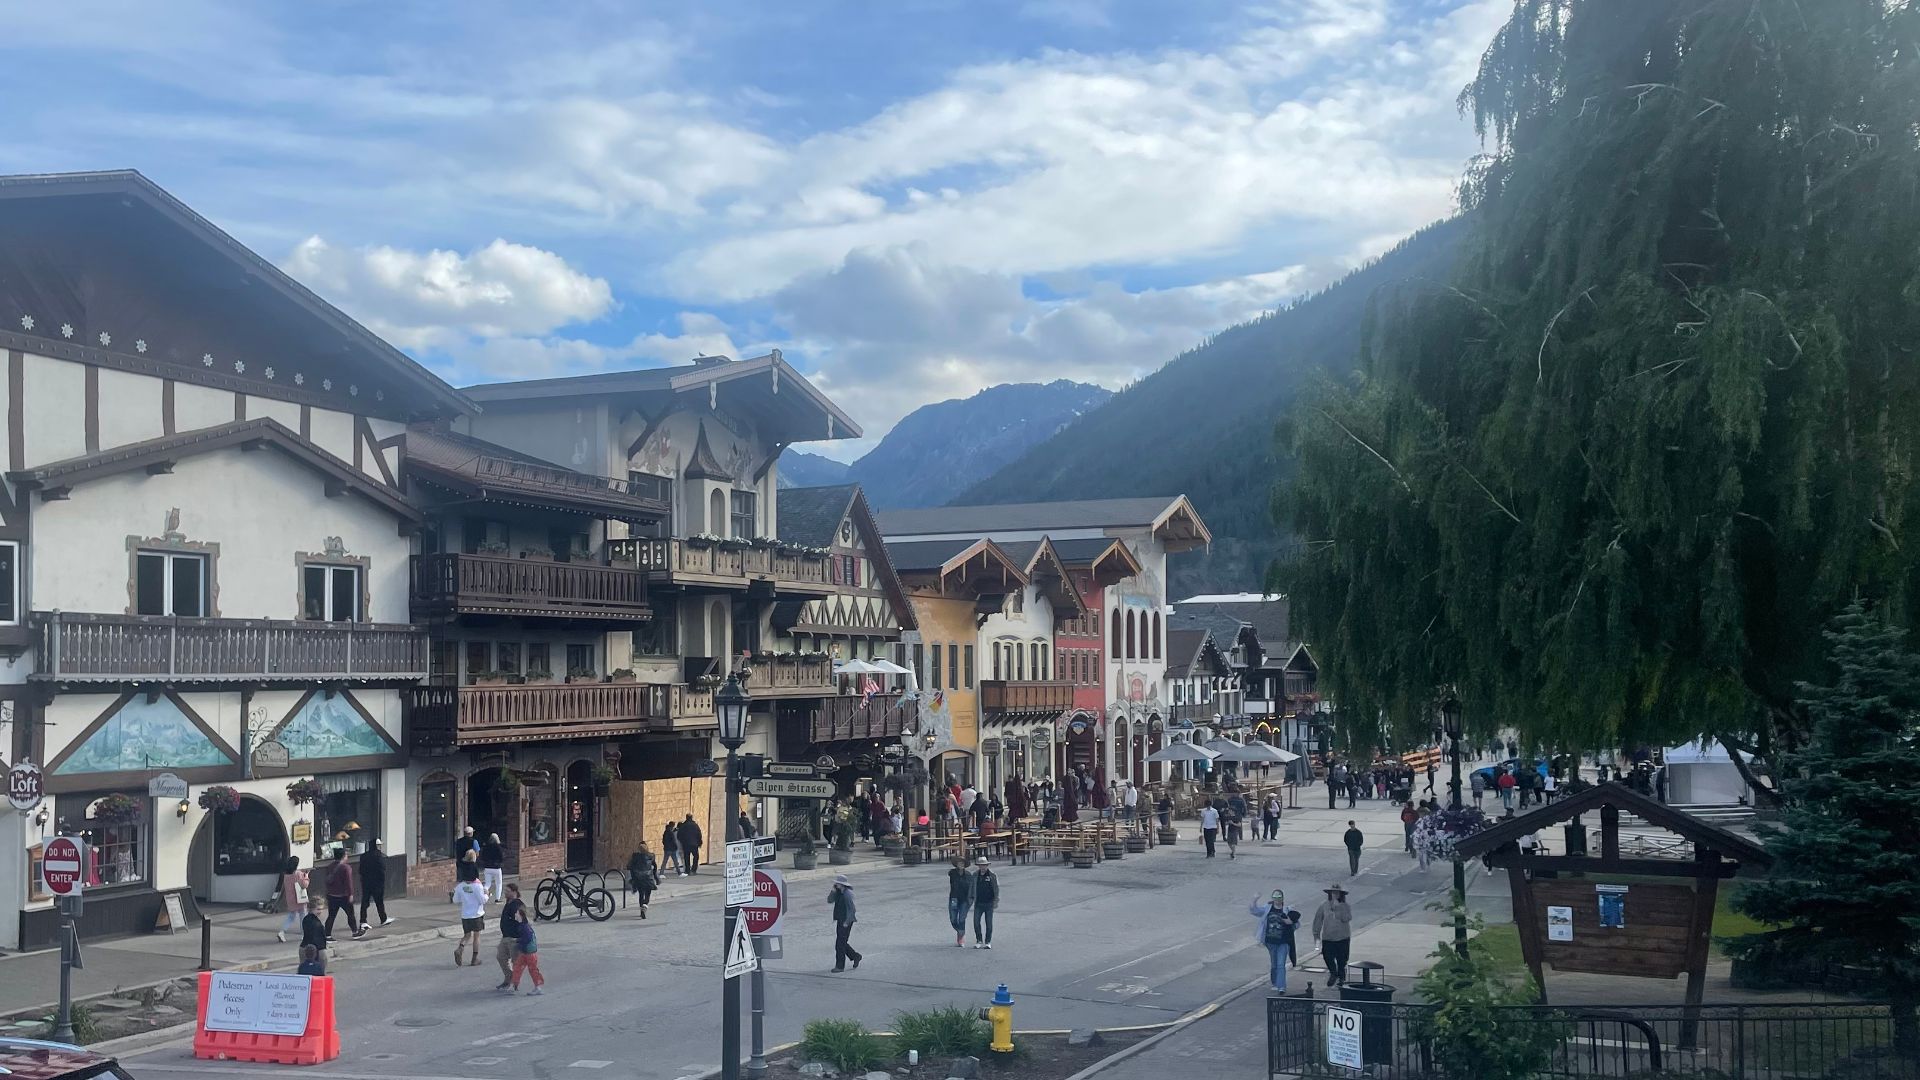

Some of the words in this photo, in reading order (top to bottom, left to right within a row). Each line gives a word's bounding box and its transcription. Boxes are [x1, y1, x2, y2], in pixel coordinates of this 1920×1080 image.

[10, 776, 38, 792] Loft
[757, 781, 784, 793] Alpen
[787, 782, 827, 794] Strasse
[48, 848, 58, 857] DO
[62, 848, 76, 857] NOT
[763, 844, 774, 855] WAY
[50, 873, 73, 883] ENTER
[754, 881, 773, 892] NOT
[744, 910, 769, 921] NTER
[218, 979, 253, 990] Pedestrian
[223, 993, 246, 1003] Access
[225, 1006, 241, 1019] Only
[1334, 1014, 1355, 1031] NO
